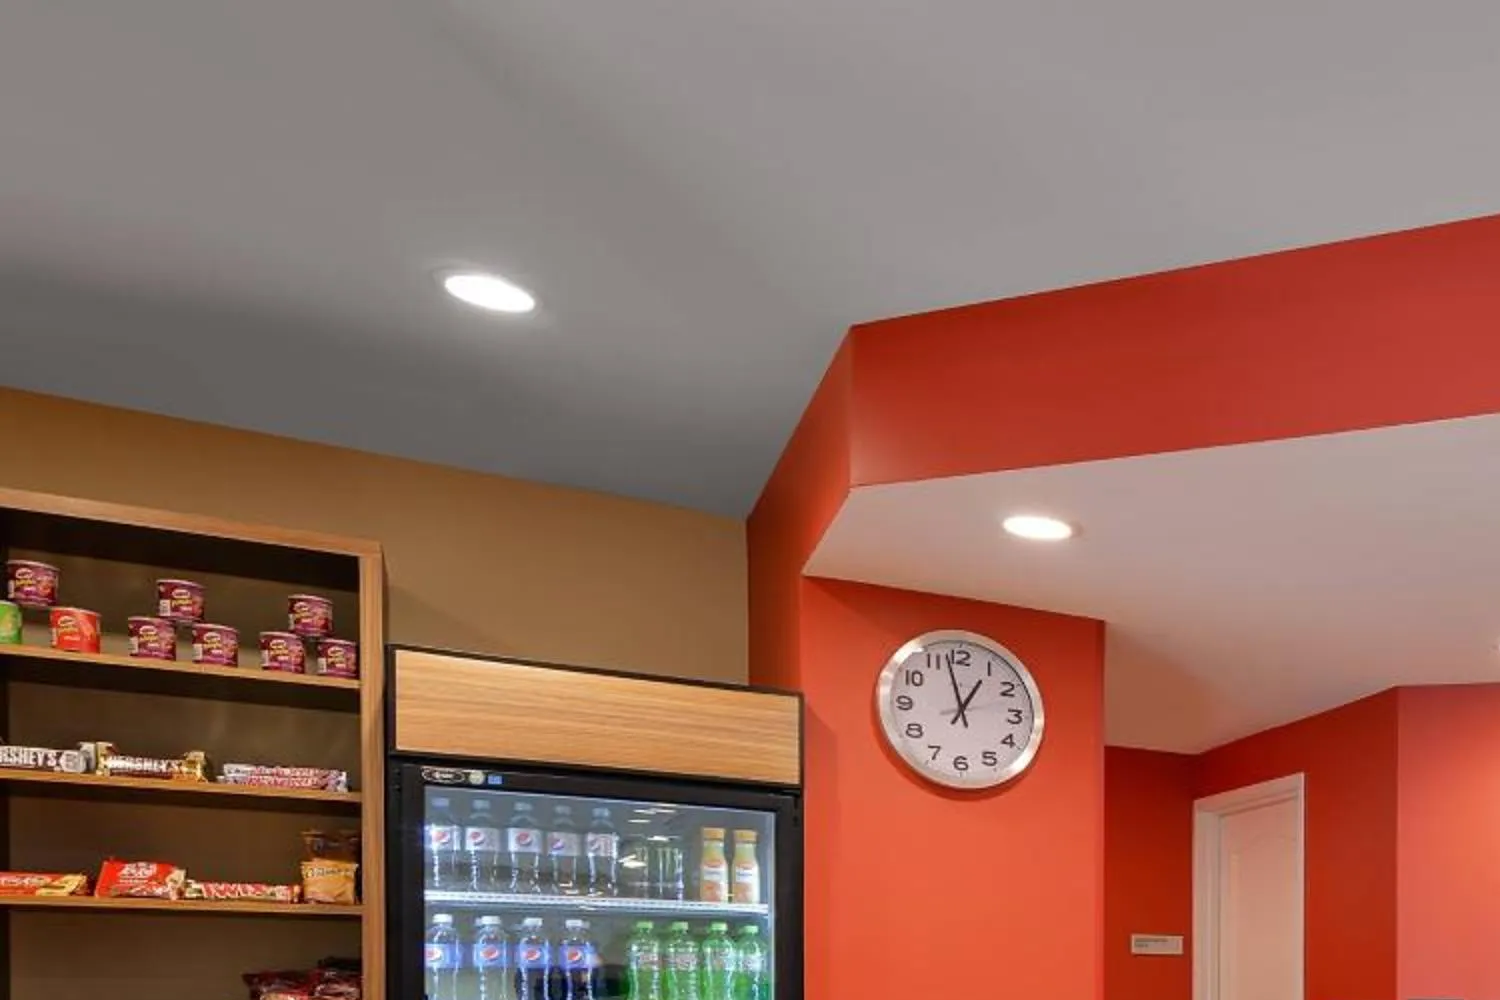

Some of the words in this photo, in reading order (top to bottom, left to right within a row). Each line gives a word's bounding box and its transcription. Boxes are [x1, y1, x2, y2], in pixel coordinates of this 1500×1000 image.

[927, 653, 941, 670] 11
[951, 649, 971, 667] 12
[986, 661, 992, 677] 1
[905, 669, 924, 686] 10
[999, 681, 1015, 697] 2
[896, 695, 913, 711] 9
[1007, 708, 1023, 725] 3
[905, 723, 924, 739] 8
[1001, 733, 1016, 748] 4
[927, 745, 941, 760] 7
[981, 751, 998, 766] 5
[953, 756, 969, 771] 6
